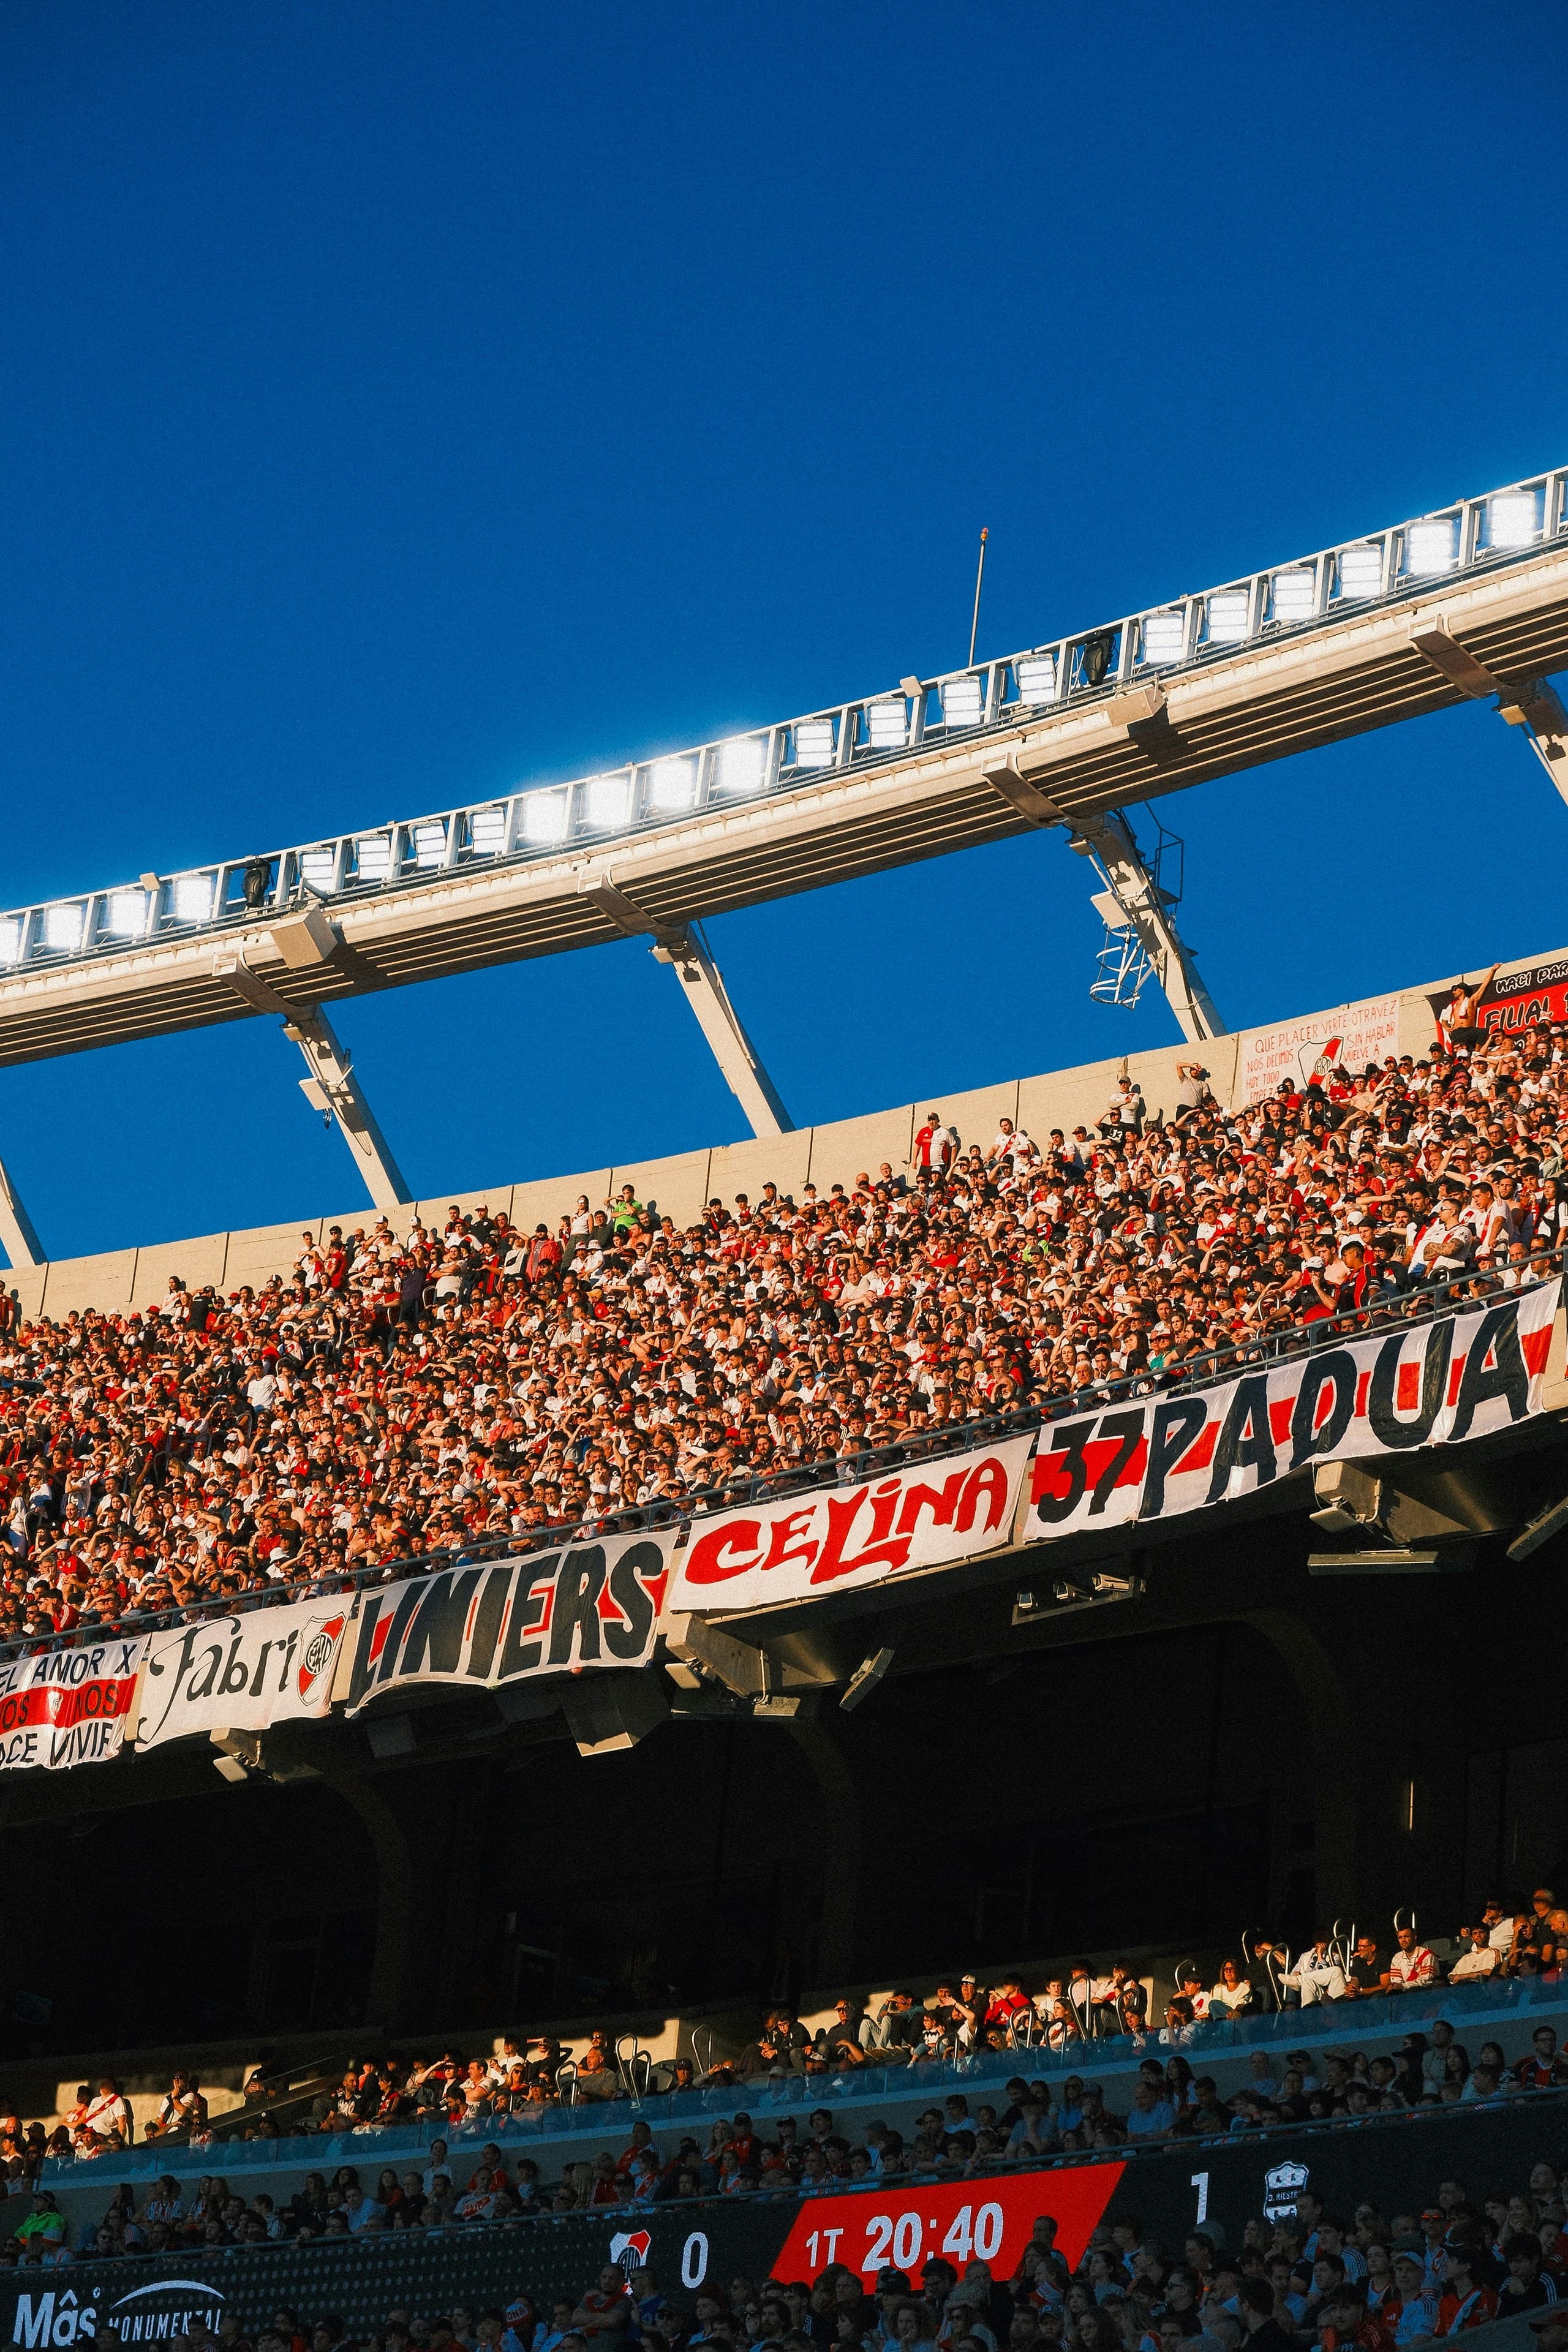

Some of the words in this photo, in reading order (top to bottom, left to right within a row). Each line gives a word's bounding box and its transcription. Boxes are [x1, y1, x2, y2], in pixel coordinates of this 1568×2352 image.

[1496, 971, 1532, 993] NACI
[1247, 1056, 1263, 1074] NOS
[1266, 1049, 1294, 1068] DECIMOS
[1347, 1034, 1363, 1049] SIN
[1366, 1021, 1396, 1041] HABLAR
[1255, 1038, 1275, 1054] QUE
[1278, 1024, 1319, 1047] PLACER
[1321, 1014, 1348, 1034] VERTE
[1246, 1076, 1260, 1090] HOY
[1263, 1070, 1280, 1084] TODO
[1343, 1046, 1370, 1062] VUELVE
[1373, 1044, 1380, 1055] A
[1037, 1406, 1147, 1525] 37
[1139, 1299, 1530, 1520] PADUA
[346, 1540, 664, 1709] LINIERS
[31, 1648, 106, 1684] AMOR
[113, 1644, 138, 1675] X
[135, 1616, 299, 1744] Fabri
[0, 1694, 30, 1730] OS
[73, 1684, 119, 1721] NOS
[1191, 2171, 1209, 2225] 1
[680, 2231, 709, 2290] 0
[804, 2228, 845, 2268] 1T
[861, 2201, 1005, 2273] 20:40
[108, 2308, 221, 2343] ONUMENAL
